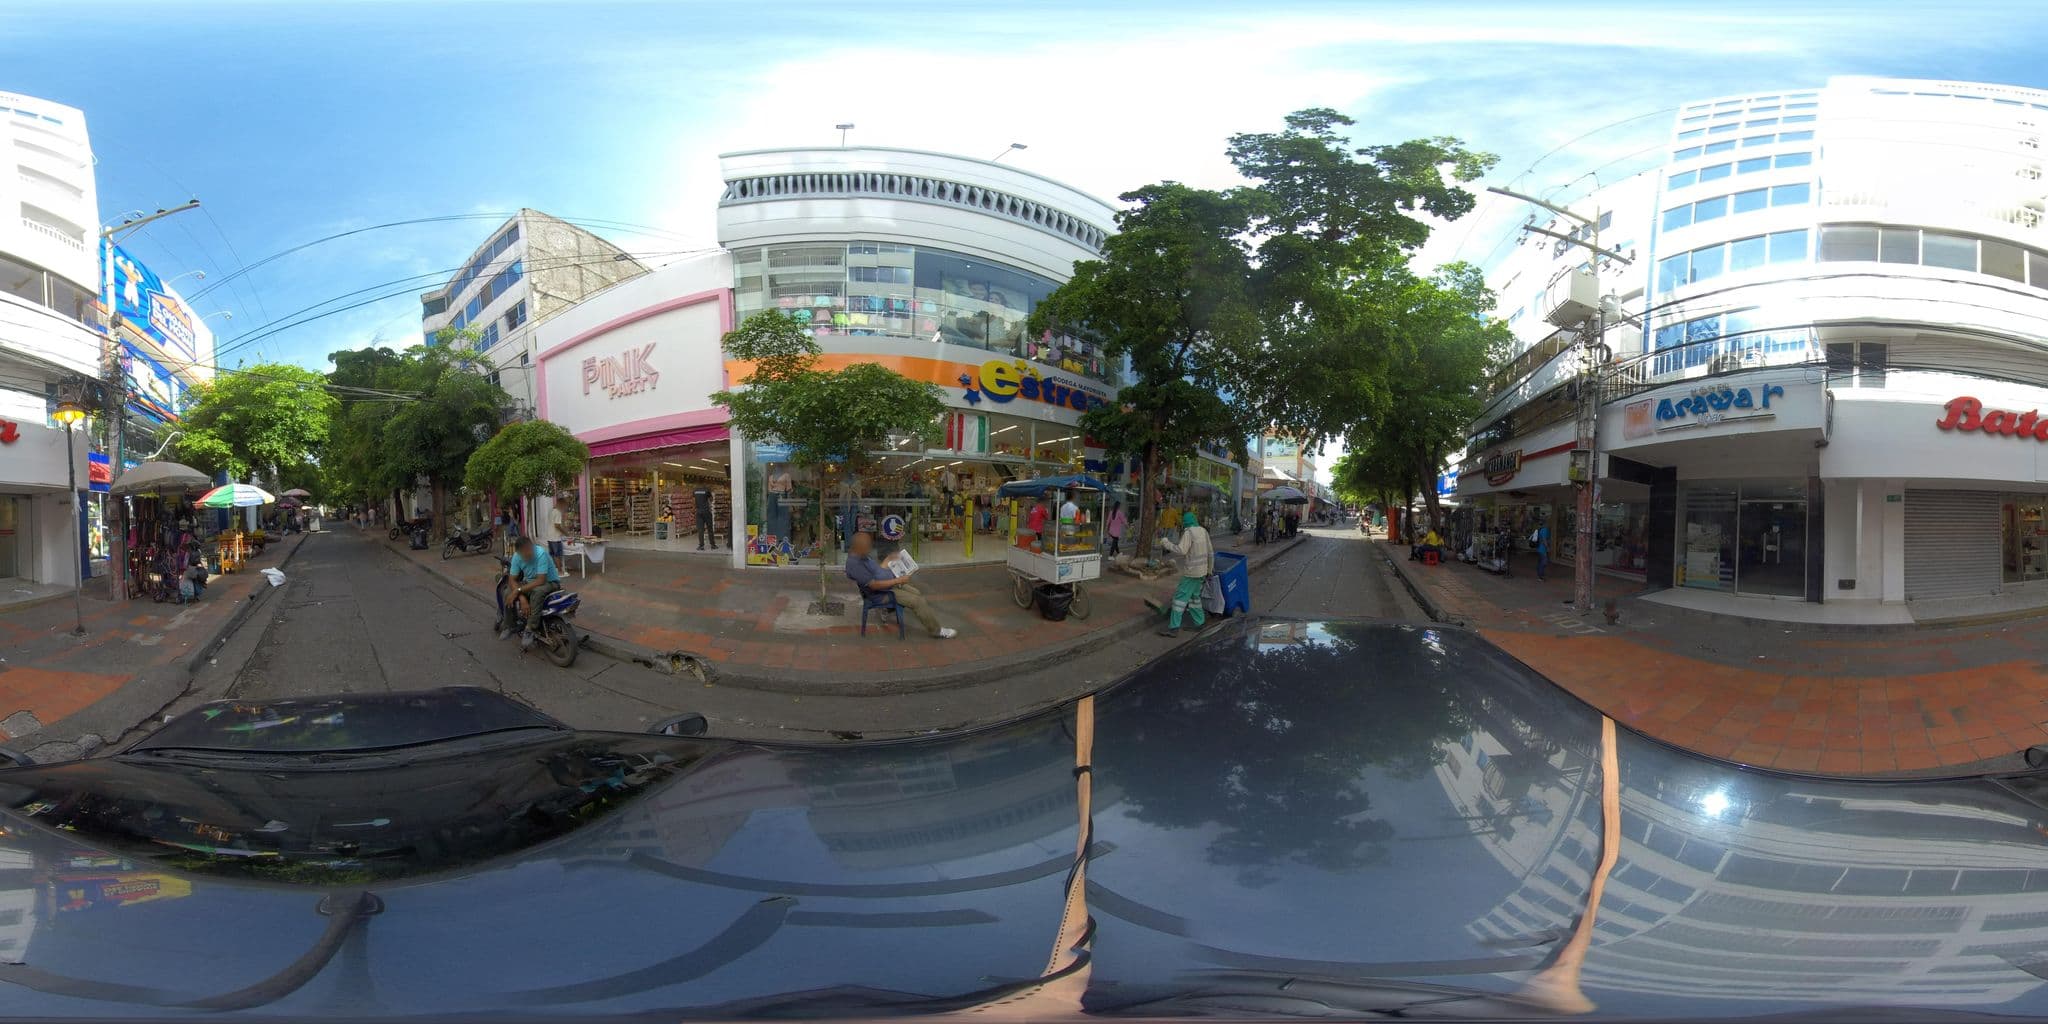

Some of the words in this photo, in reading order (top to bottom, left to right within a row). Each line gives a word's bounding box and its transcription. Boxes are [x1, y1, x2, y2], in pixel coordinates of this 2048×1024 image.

[582, 342, 659, 395] PINK
[1053, 375, 1077, 388] BODEGA
[608, 372, 659, 400] PARTY
